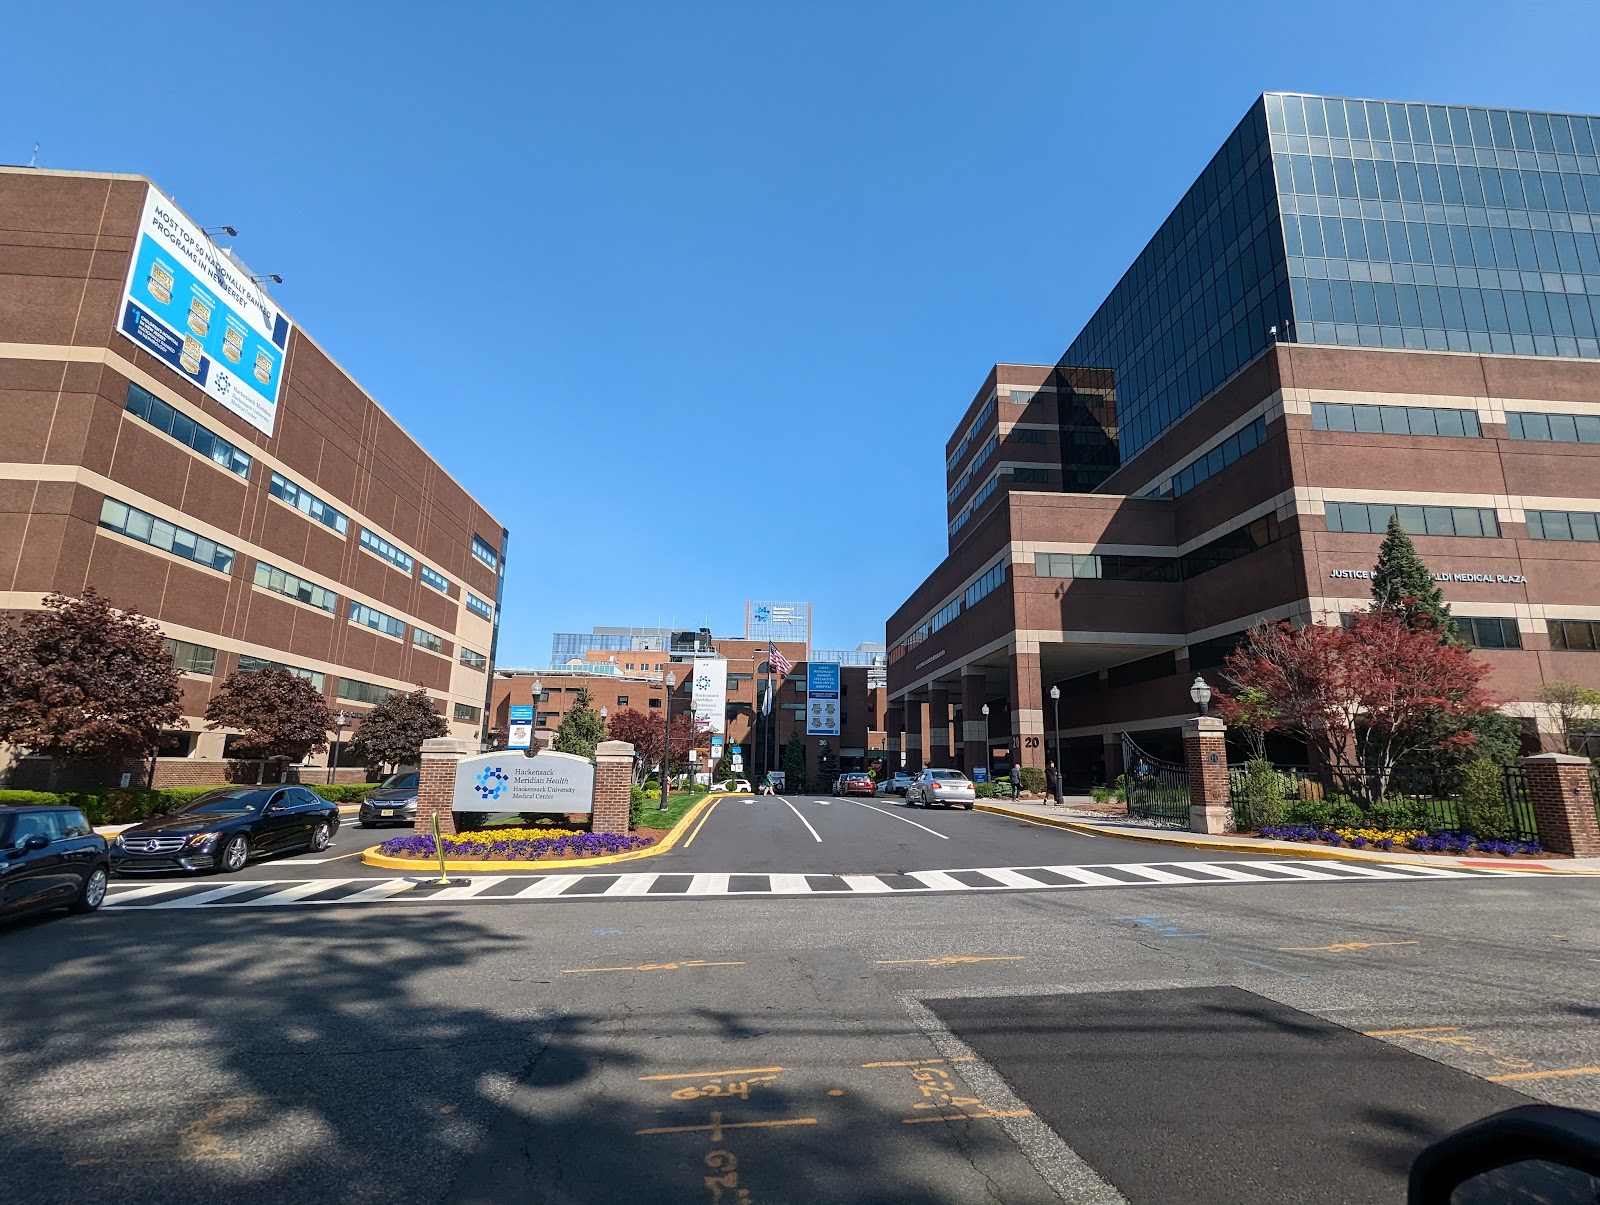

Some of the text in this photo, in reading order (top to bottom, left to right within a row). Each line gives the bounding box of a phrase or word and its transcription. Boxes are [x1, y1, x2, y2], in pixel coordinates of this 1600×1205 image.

[152, 216, 248, 309] PROGRAMS IN NEW JERSEY
[154, 206, 272, 319] MOST TOP 50 NATIONALLY RANKED
[1330, 570, 1368, 580] JUSTICE
[1454, 573, 1494, 583] MEDICAL
[1497, 574, 1528, 584] PLAZA
[1012, 736, 1020, 748] 20
[1024, 736, 1040, 748] 20
